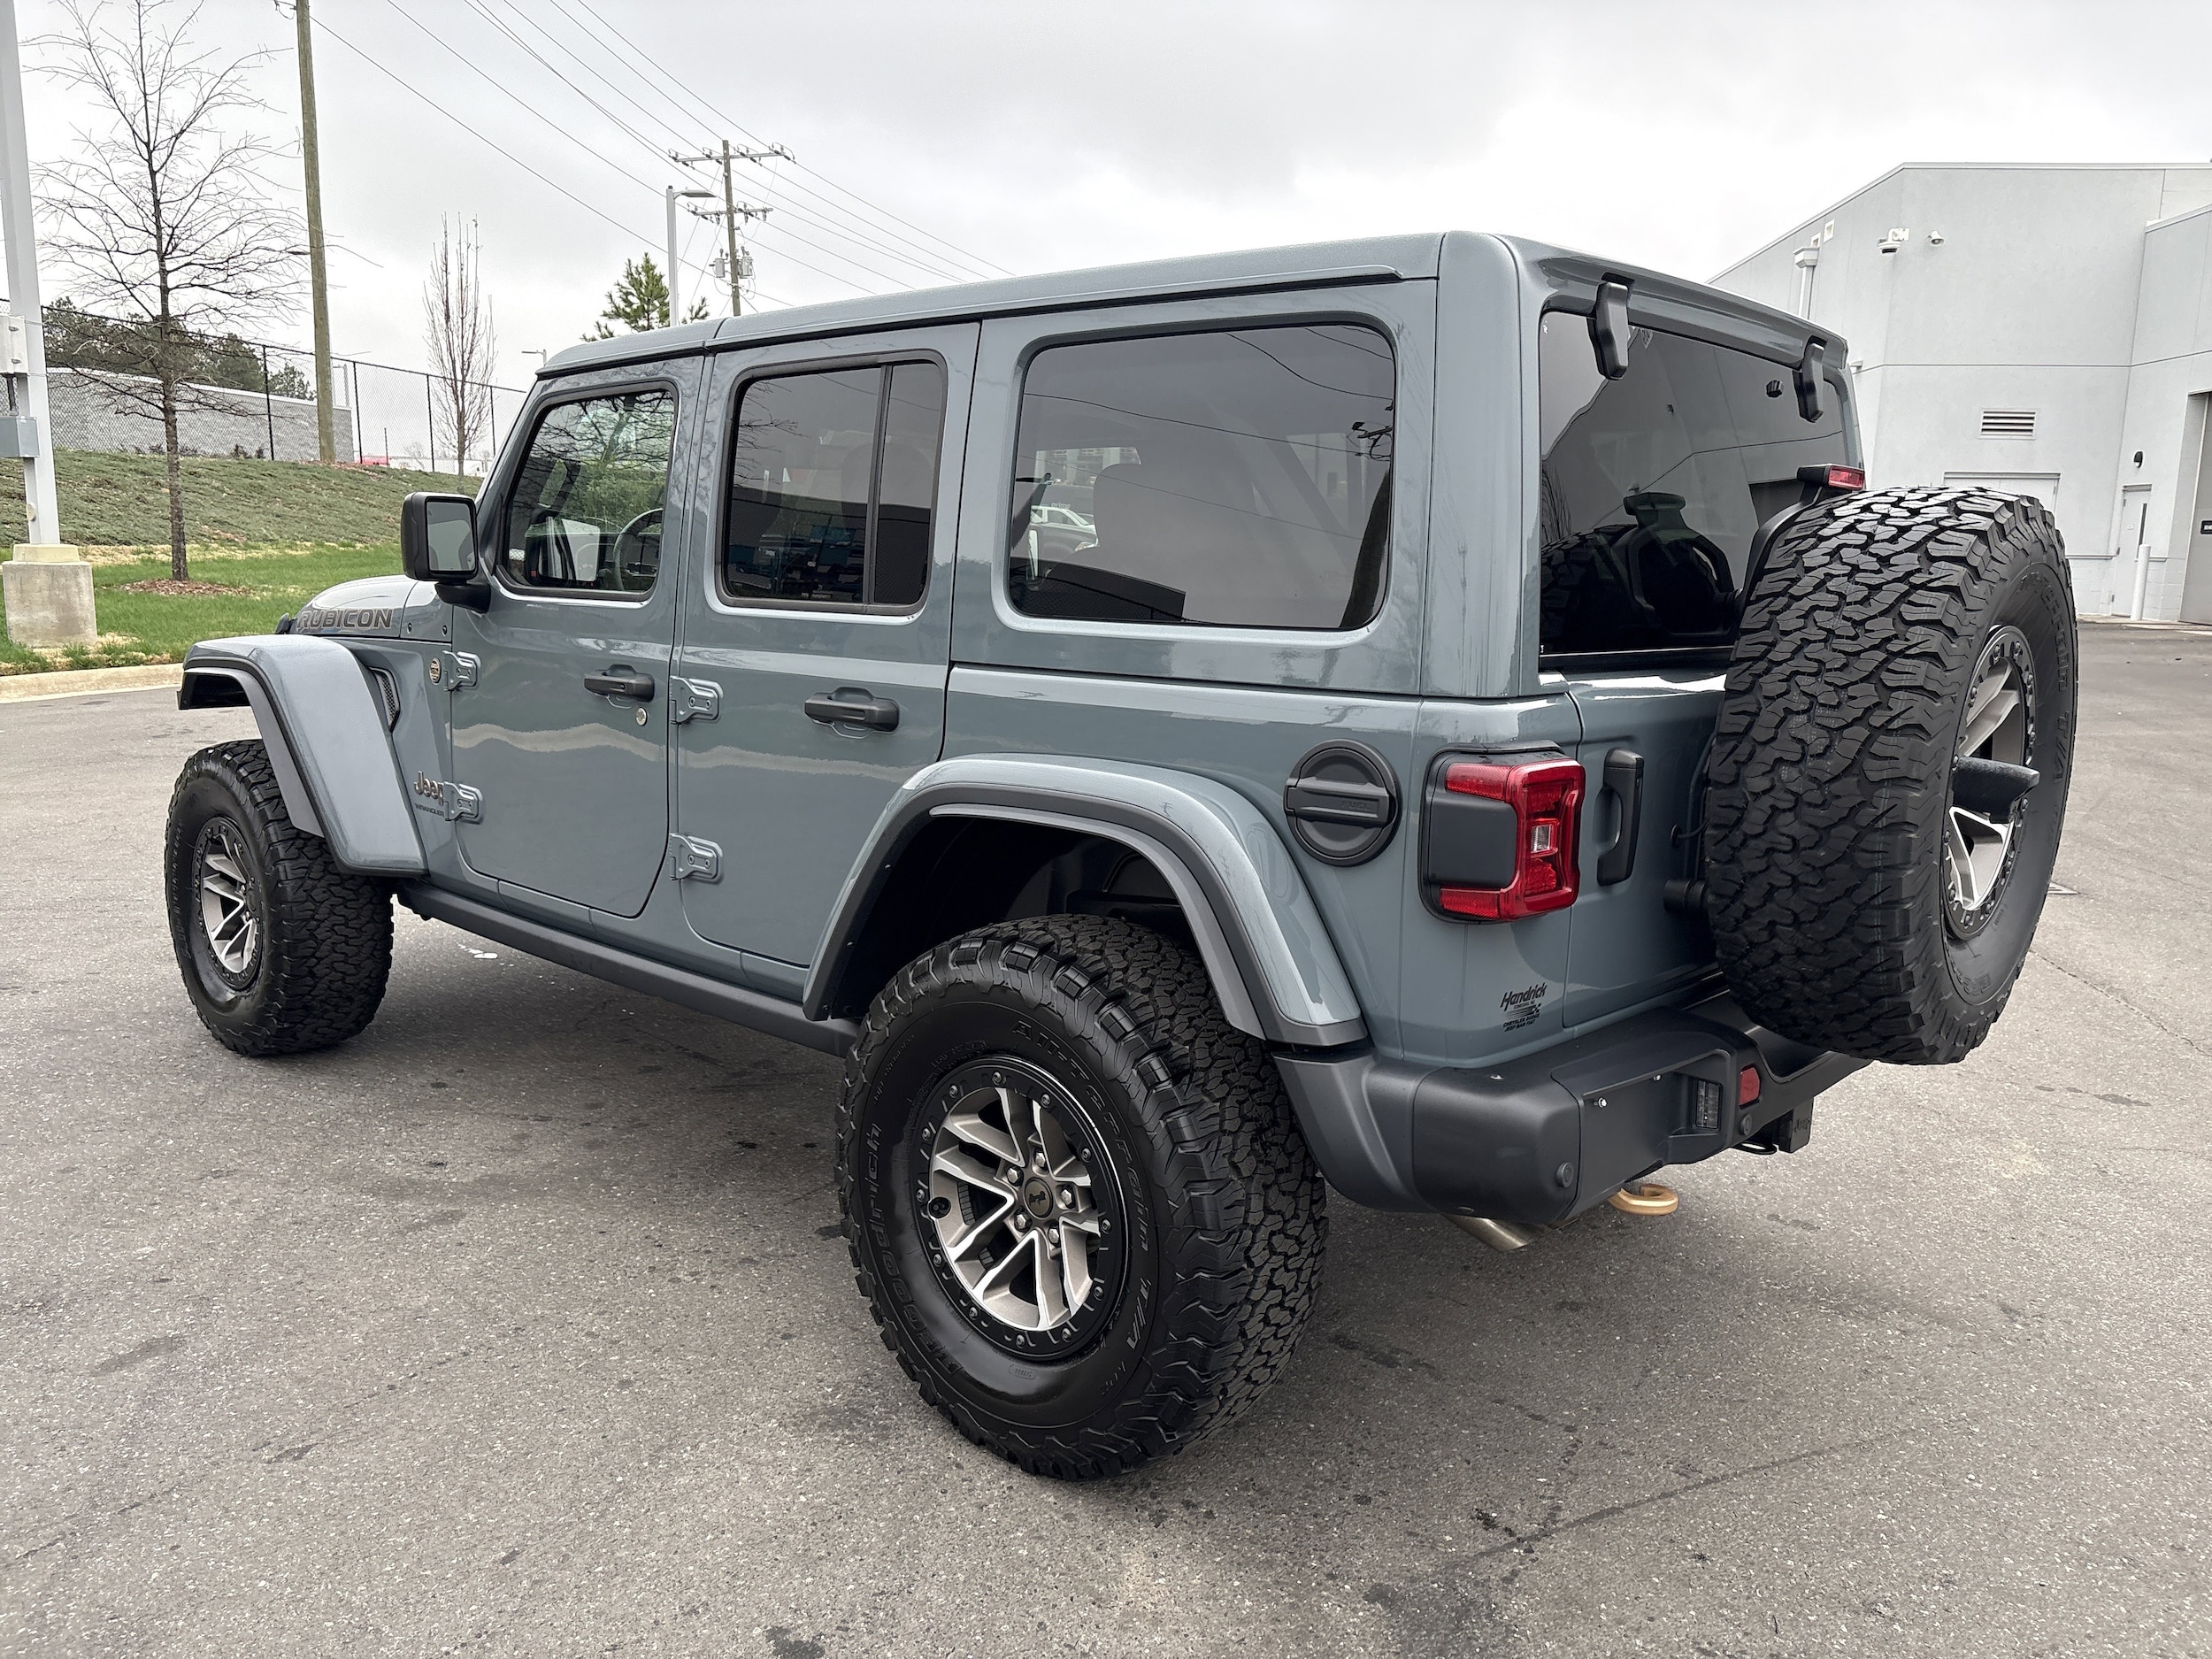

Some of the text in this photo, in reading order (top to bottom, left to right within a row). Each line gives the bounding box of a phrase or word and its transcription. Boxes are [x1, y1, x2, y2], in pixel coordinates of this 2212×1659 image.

[296, 608, 394, 632] RUBICON
[413, 770, 444, 806] Jeep
[414, 803, 445, 818] WRANGLER
[1340, 800, 1372, 812] FUEL
[1500, 982, 1548, 1011] Hendrick
